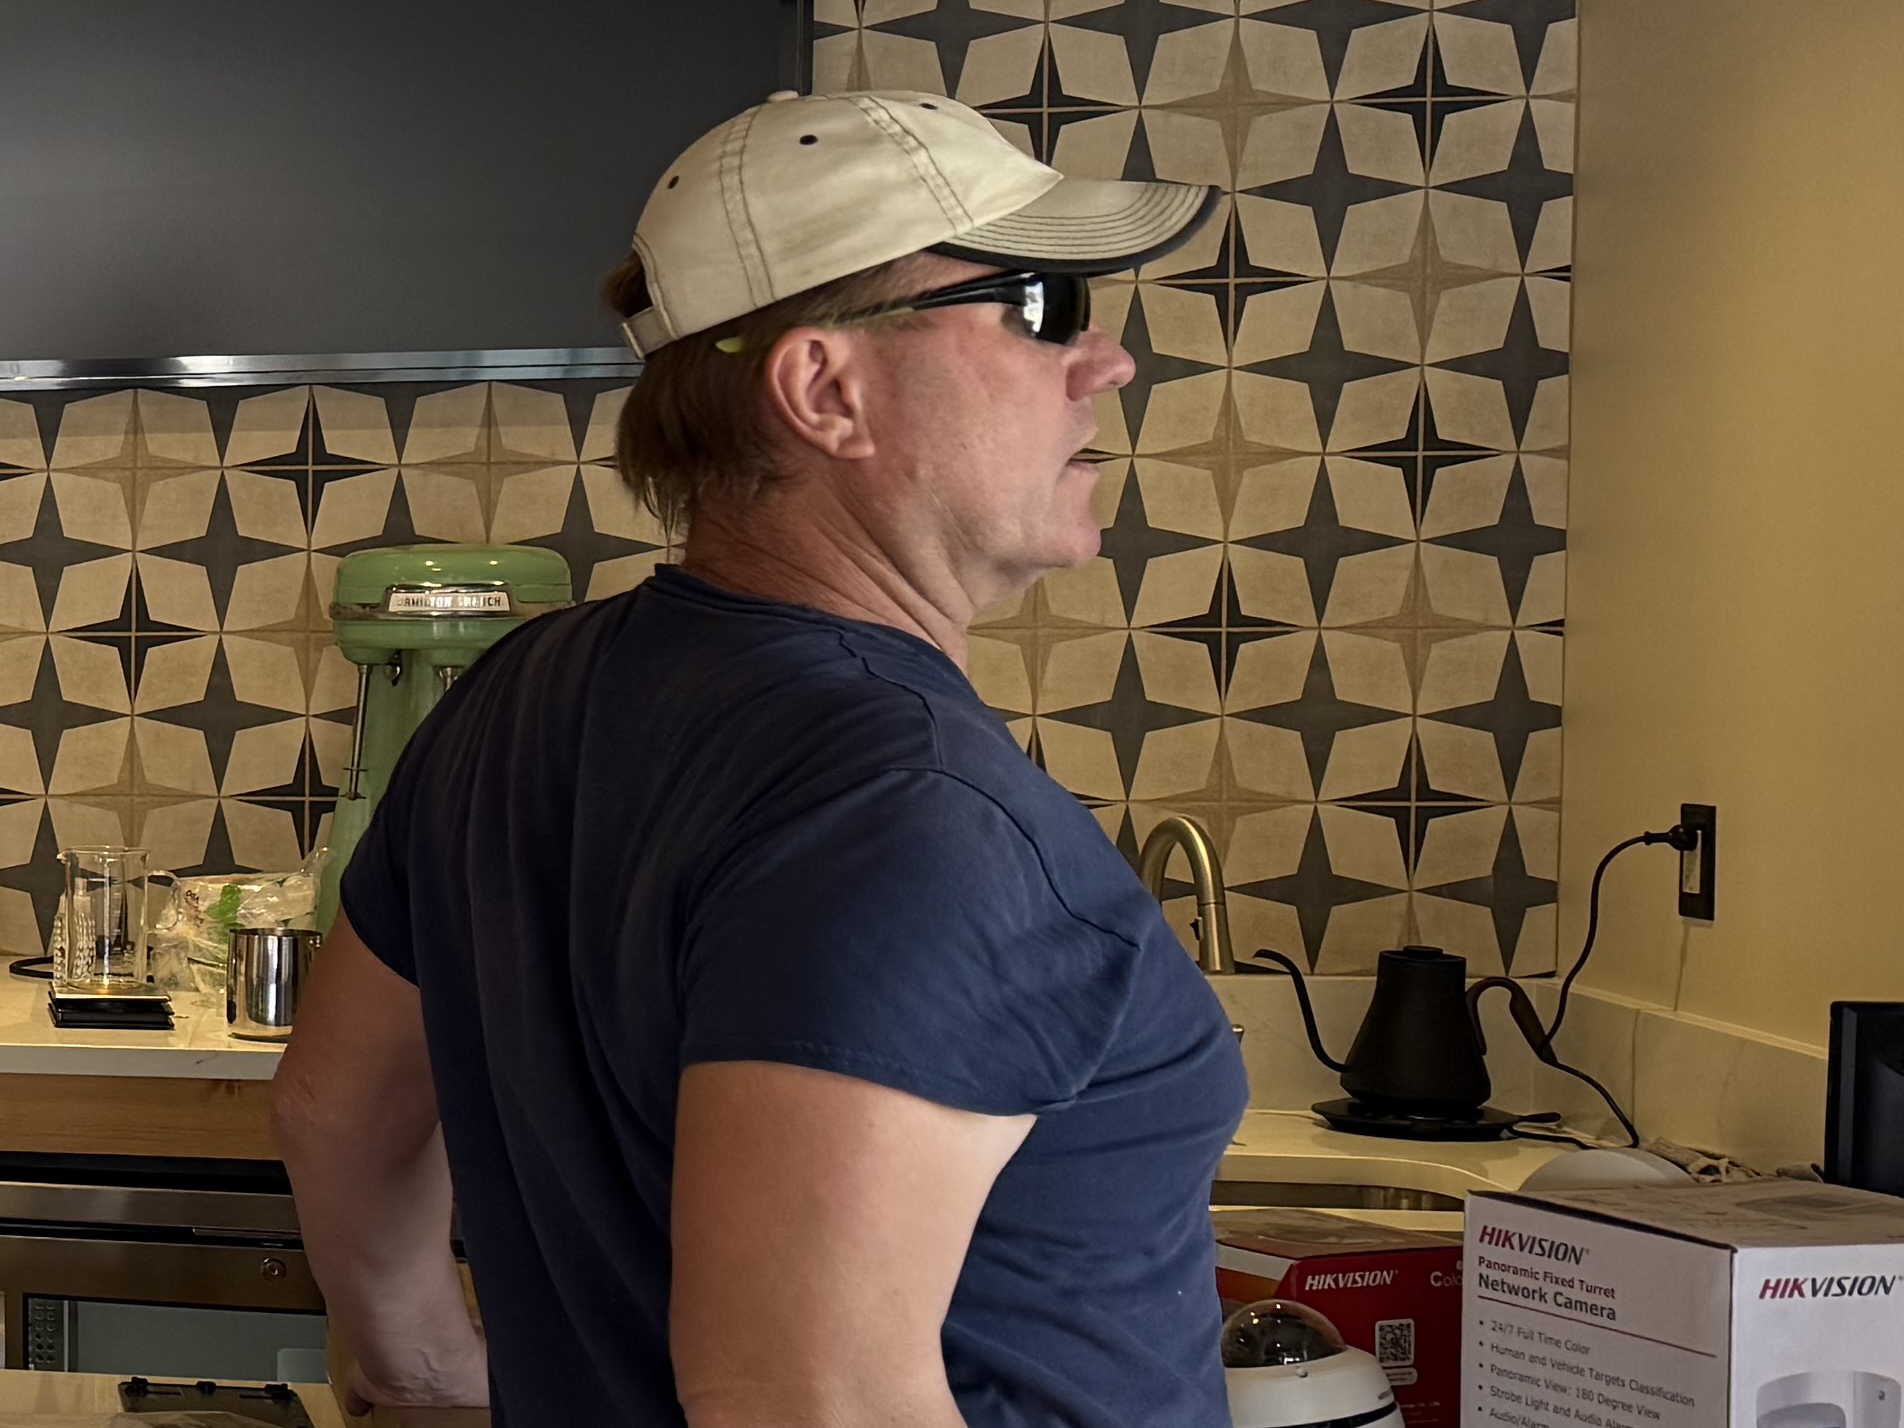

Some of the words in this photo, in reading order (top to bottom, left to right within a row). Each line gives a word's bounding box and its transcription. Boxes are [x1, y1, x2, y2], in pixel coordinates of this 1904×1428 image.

[1478, 1224, 1585, 1266] HIKVISION
[1304, 1270, 1393, 1290] HIKVISION
[1478, 1255, 1540, 1281] Panoramic
[1543, 1271, 1575, 1289] Fixed
[1578, 1279, 1616, 1300] Turret
[1478, 1272, 1548, 1305] Network
[1553, 1291, 1617, 1321] Camera
[1758, 1274, 1897, 1300] HIKVISION
[1517, 1327, 1535, 1342] Full
[1537, 1332, 1562, 1349] Time
[1564, 1339, 1591, 1356] Color
[1490, 1343, 1526, 1361] Human
[1529, 1352, 1547, 1367] and
[1549, 1358, 1586, 1377] Vehicle
[1588, 1368, 1626, 1390] Targets
[1628, 1379, 1696, 1408] Classification
[1490, 1364, 1542, 1388] Panoramic
[1597, 1393, 1635, 1415] Degree
[1636, 1403, 1661, 1421] View
[1489, 1386, 1523, 1404] Strobe
[1525, 1394, 1550, 1413] Light
[1552, 1402, 1572, 1418] and
